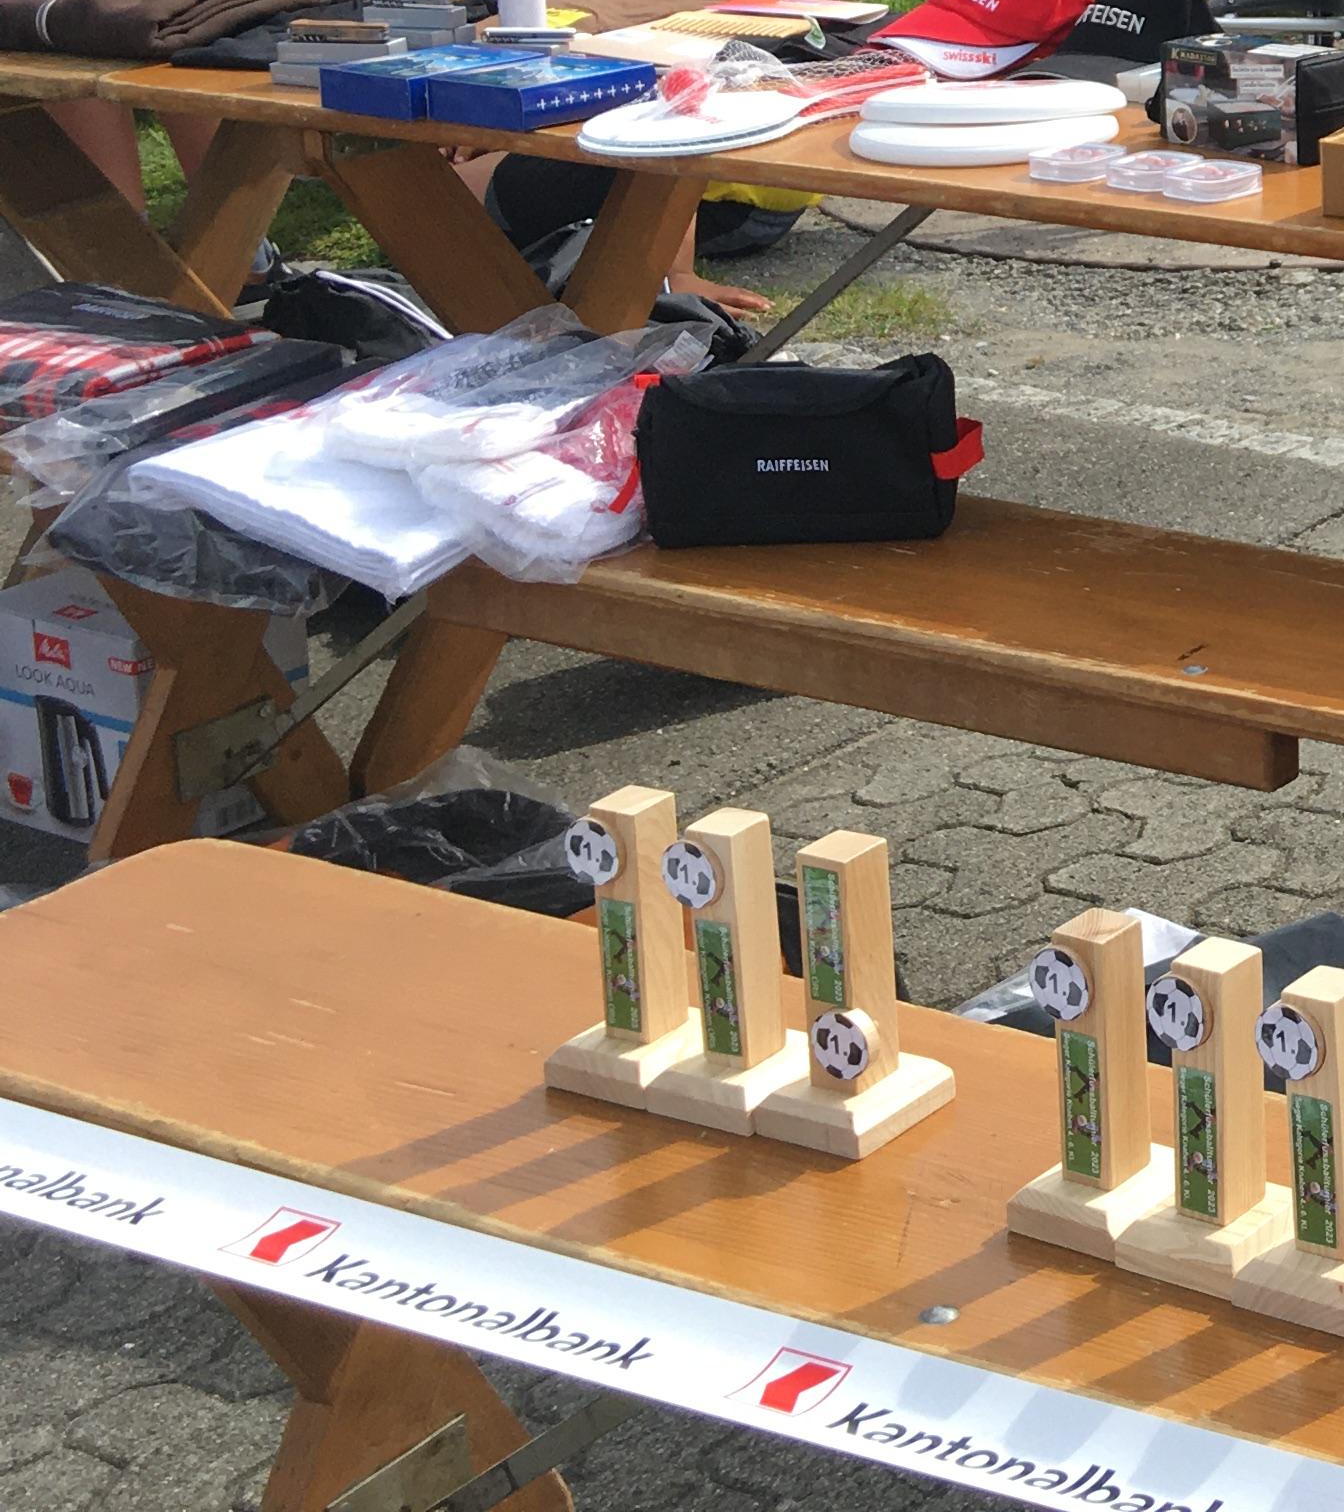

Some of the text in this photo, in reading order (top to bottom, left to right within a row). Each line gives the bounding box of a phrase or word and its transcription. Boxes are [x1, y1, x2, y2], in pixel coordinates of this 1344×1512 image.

[757, 459, 830, 472] RAIFFEISEN
[110, 659, 132, 674] NEW
[15, 665, 97, 696] LOOK AQUA
[834, 979, 842, 1002] 2023
[1048, 973, 1067, 997] 1.
[1166, 1001, 1185, 1026] 1.
[830, 1035, 848, 1057] 1.
[1275, 1030, 1295, 1055] 1.
[1091, 1151, 1099, 1174] 2023
[1207, 1189, 1215, 1212] 2023
[1325, 1219, 1334, 1243] 2023
[304, 1252, 656, 1372] Kantonalbank
